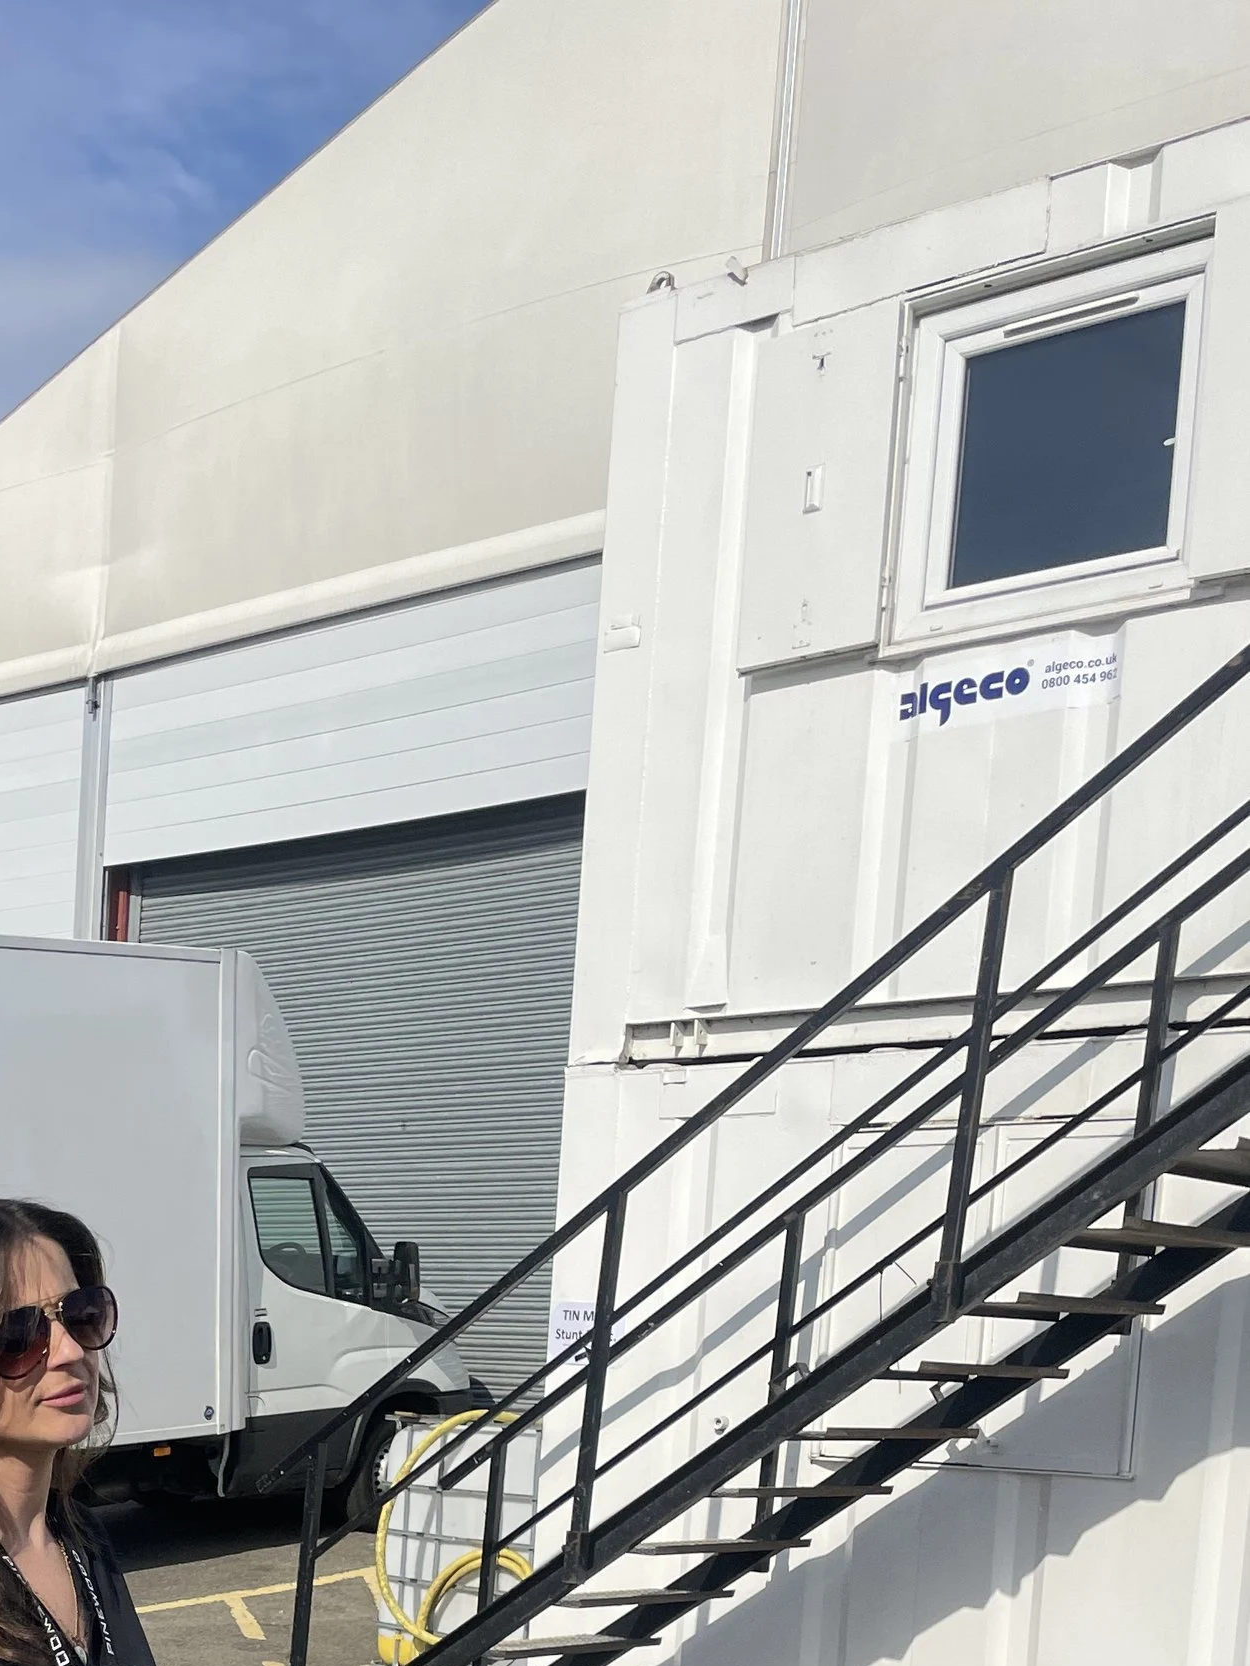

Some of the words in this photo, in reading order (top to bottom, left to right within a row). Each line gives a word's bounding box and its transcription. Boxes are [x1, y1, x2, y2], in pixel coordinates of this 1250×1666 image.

[1044, 652, 1118, 674] algeco.co.uk
[1041, 674, 1070, 690] 0800
[1073, 671, 1097, 685] 454
[899, 666, 1031, 727] algeco
[563, 1309, 580, 1320] TIN
[555, 1328, 583, 1340] Stunt
